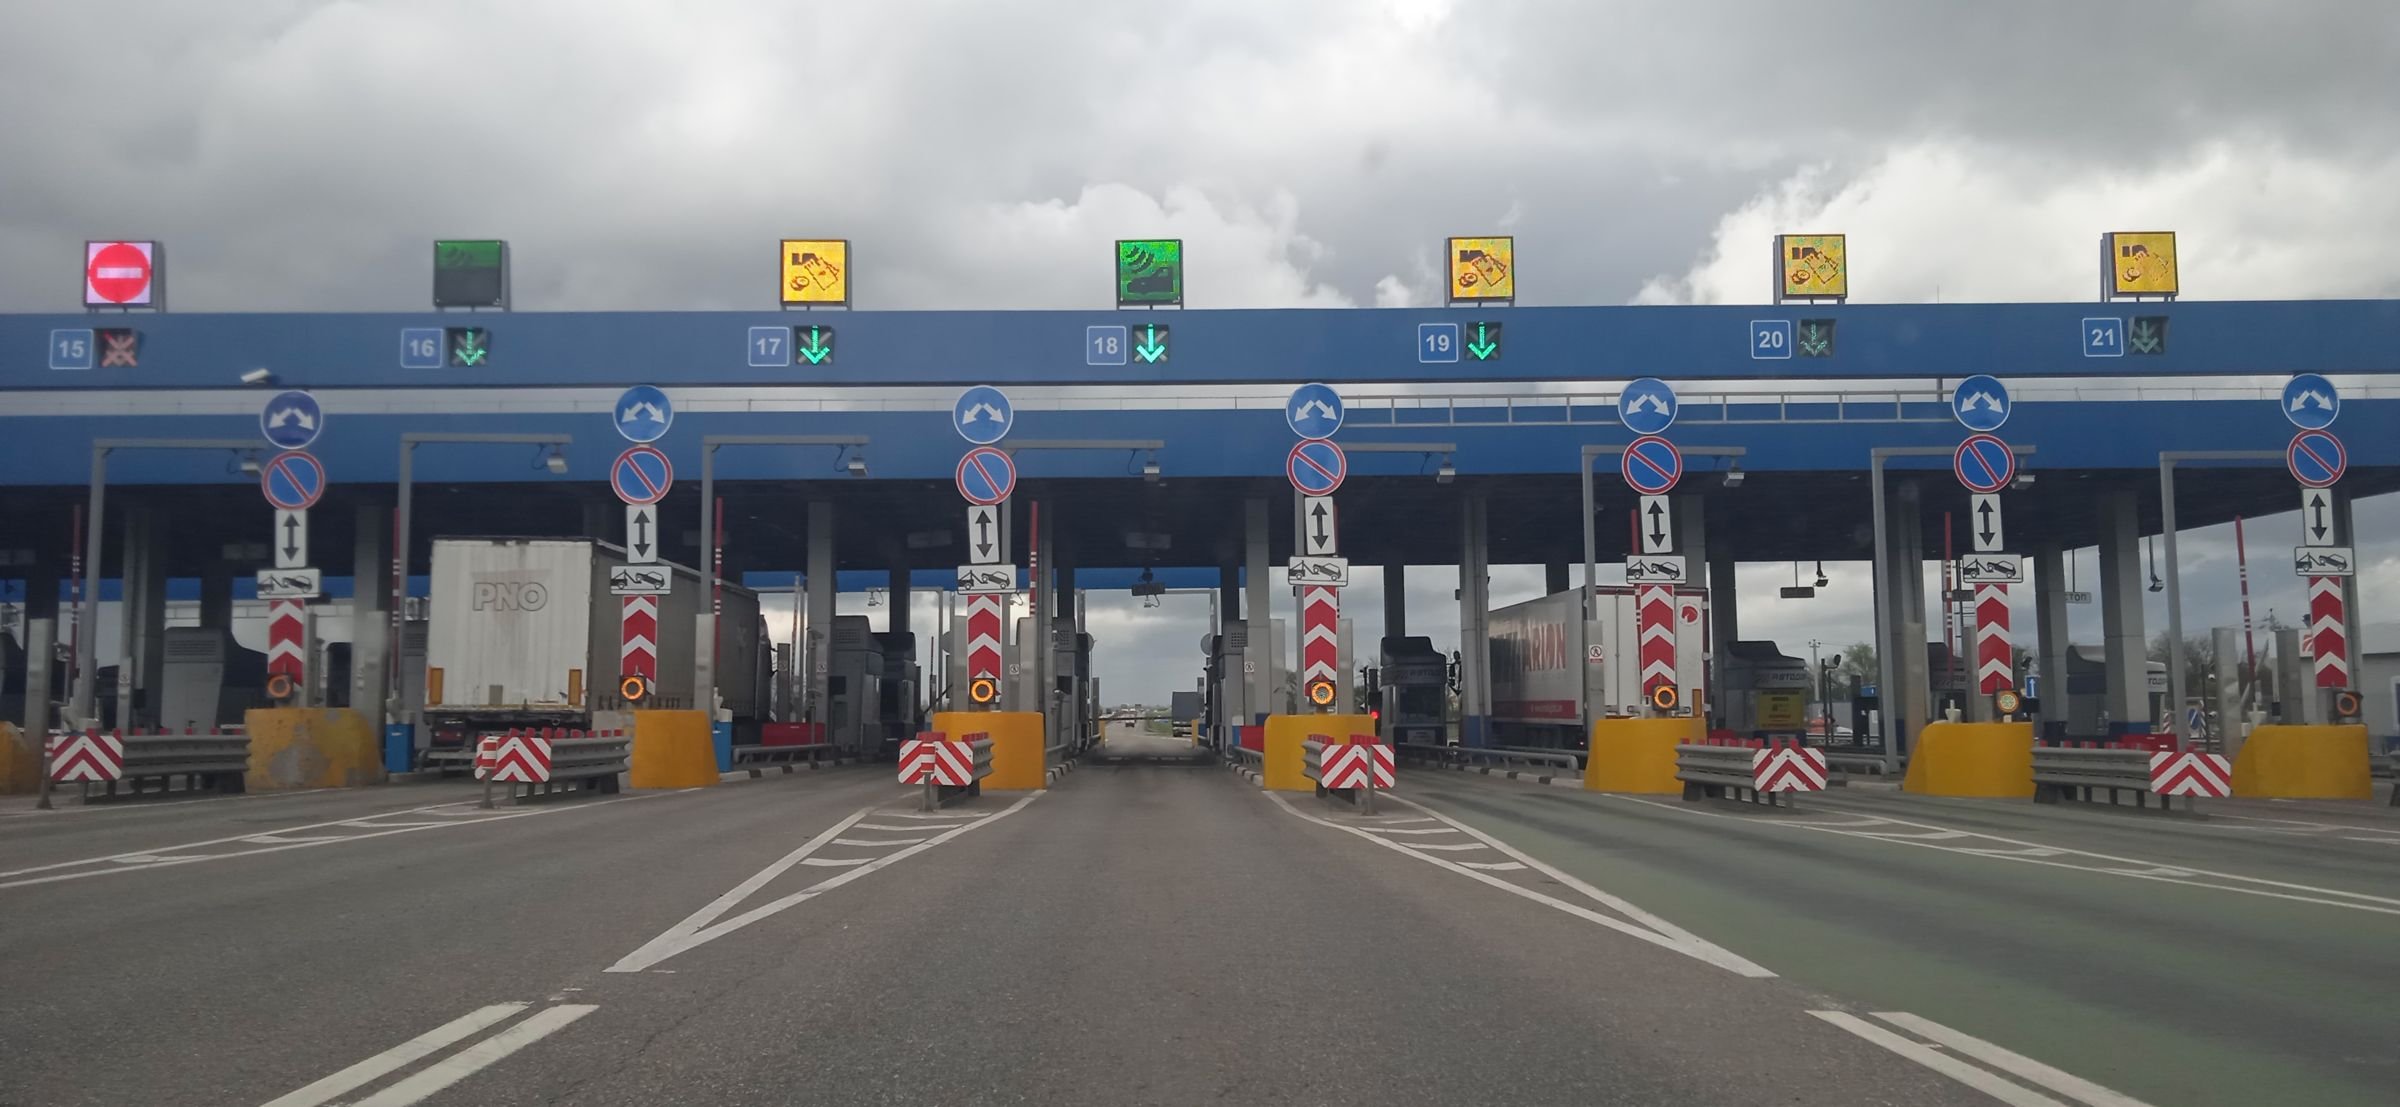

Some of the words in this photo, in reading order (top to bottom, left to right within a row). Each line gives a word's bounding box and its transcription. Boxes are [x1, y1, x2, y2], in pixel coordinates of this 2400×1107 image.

[1094, 337, 1117, 354] 18
[1426, 334, 1449, 352] 19
[1759, 331, 1784, 348] 20
[2091, 328, 2114, 346] 21
[59, 340, 84, 359] 15
[409, 338, 434, 358] 16
[757, 338, 781, 355] 17
[472, 582, 548, 612] PNO
